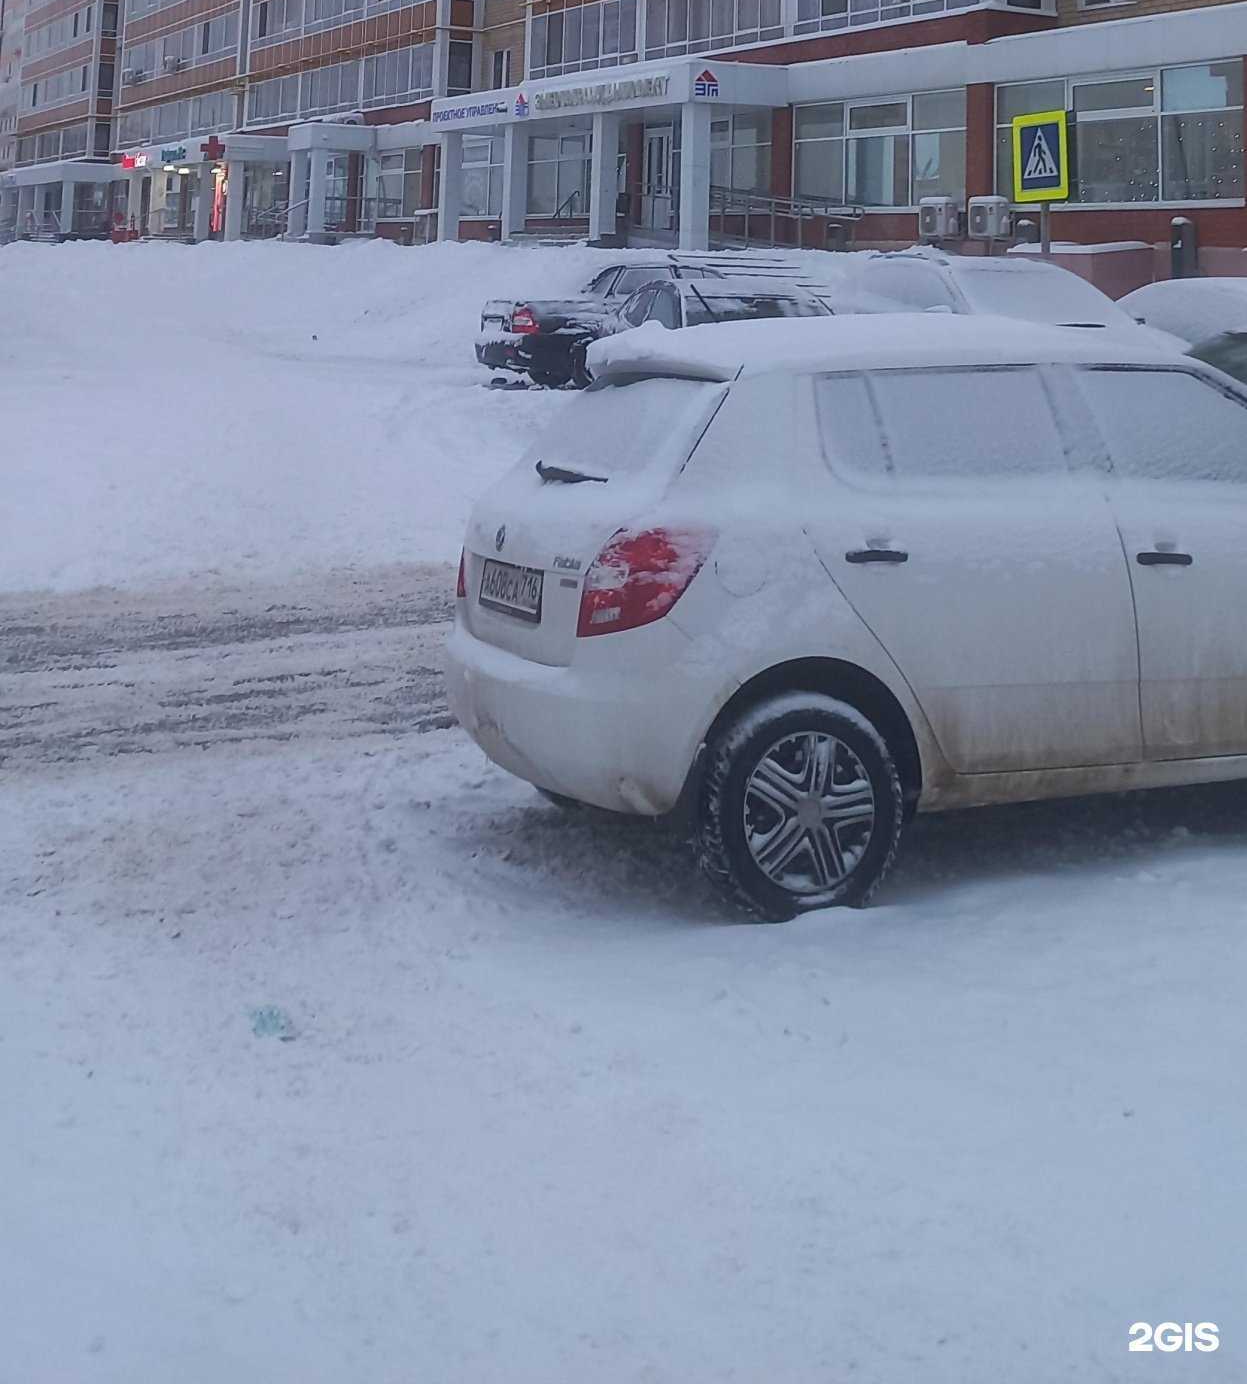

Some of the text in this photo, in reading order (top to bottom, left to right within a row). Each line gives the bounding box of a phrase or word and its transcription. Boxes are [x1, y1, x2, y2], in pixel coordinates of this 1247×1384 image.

[432, 102, 507, 123] ПРОЕКТНОЕ УПРАВЛЕН
[553, 556, 581, 570] Fabia
